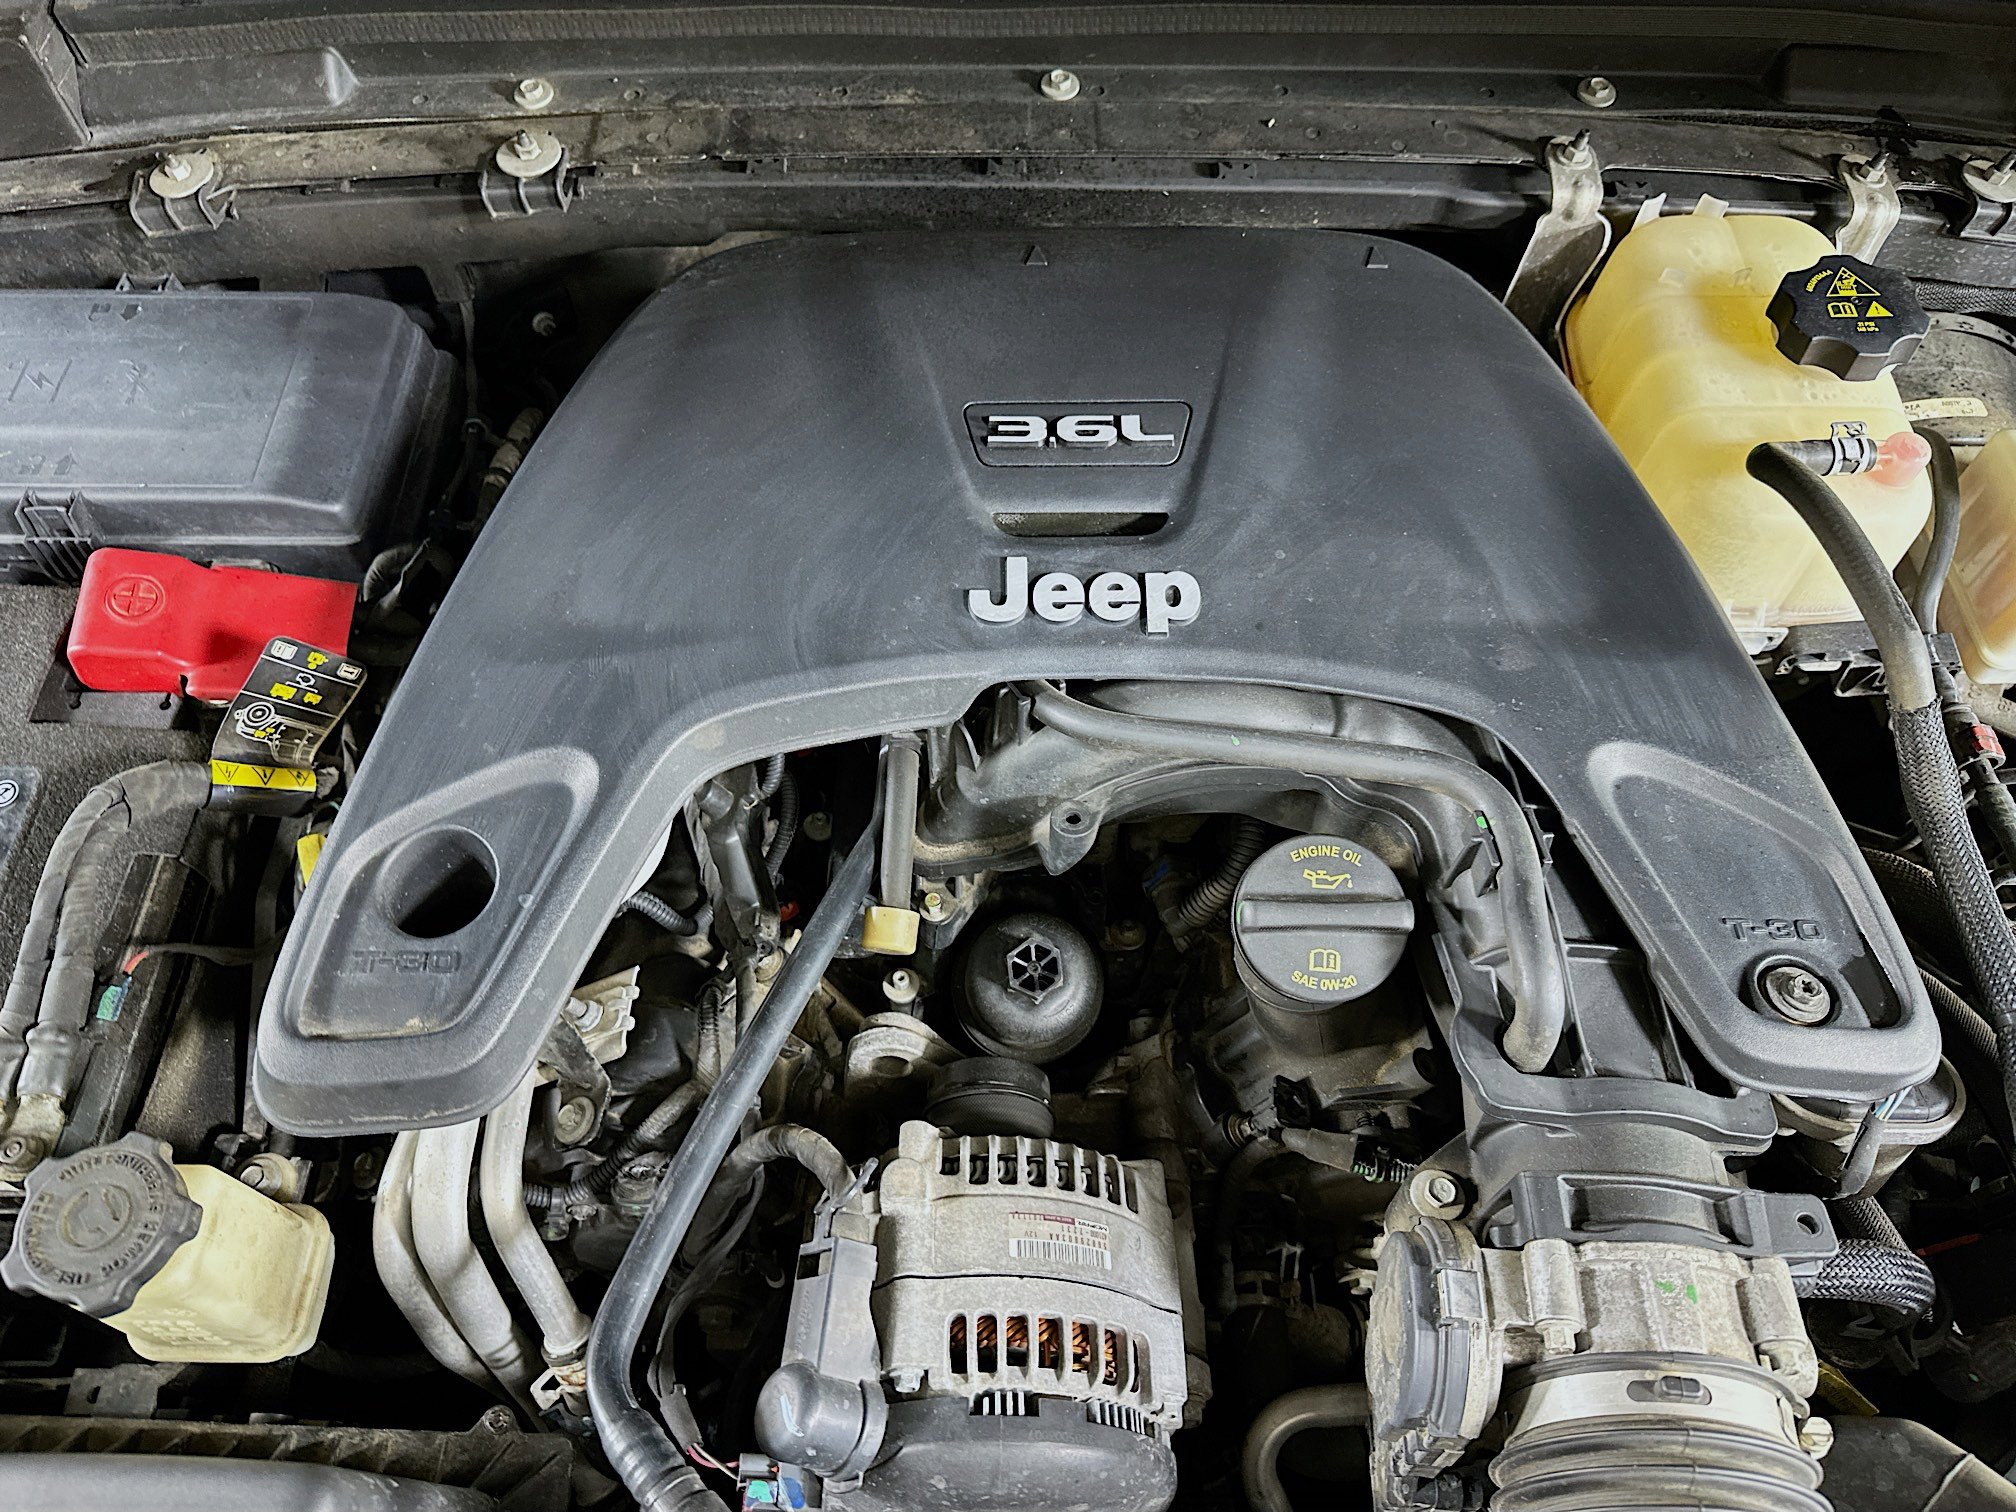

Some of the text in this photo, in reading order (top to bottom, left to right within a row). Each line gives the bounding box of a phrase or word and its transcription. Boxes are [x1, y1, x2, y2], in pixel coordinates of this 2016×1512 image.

[985, 414, 1175, 449] 3.6L
[967, 556, 1202, 638] Jeep
[1290, 845, 1362, 867] ENGINE OIL
[1720, 916, 1827, 942] T-30
[353, 949, 462, 975] T-30
[1291, 970, 1358, 991] SAE 0W-20
